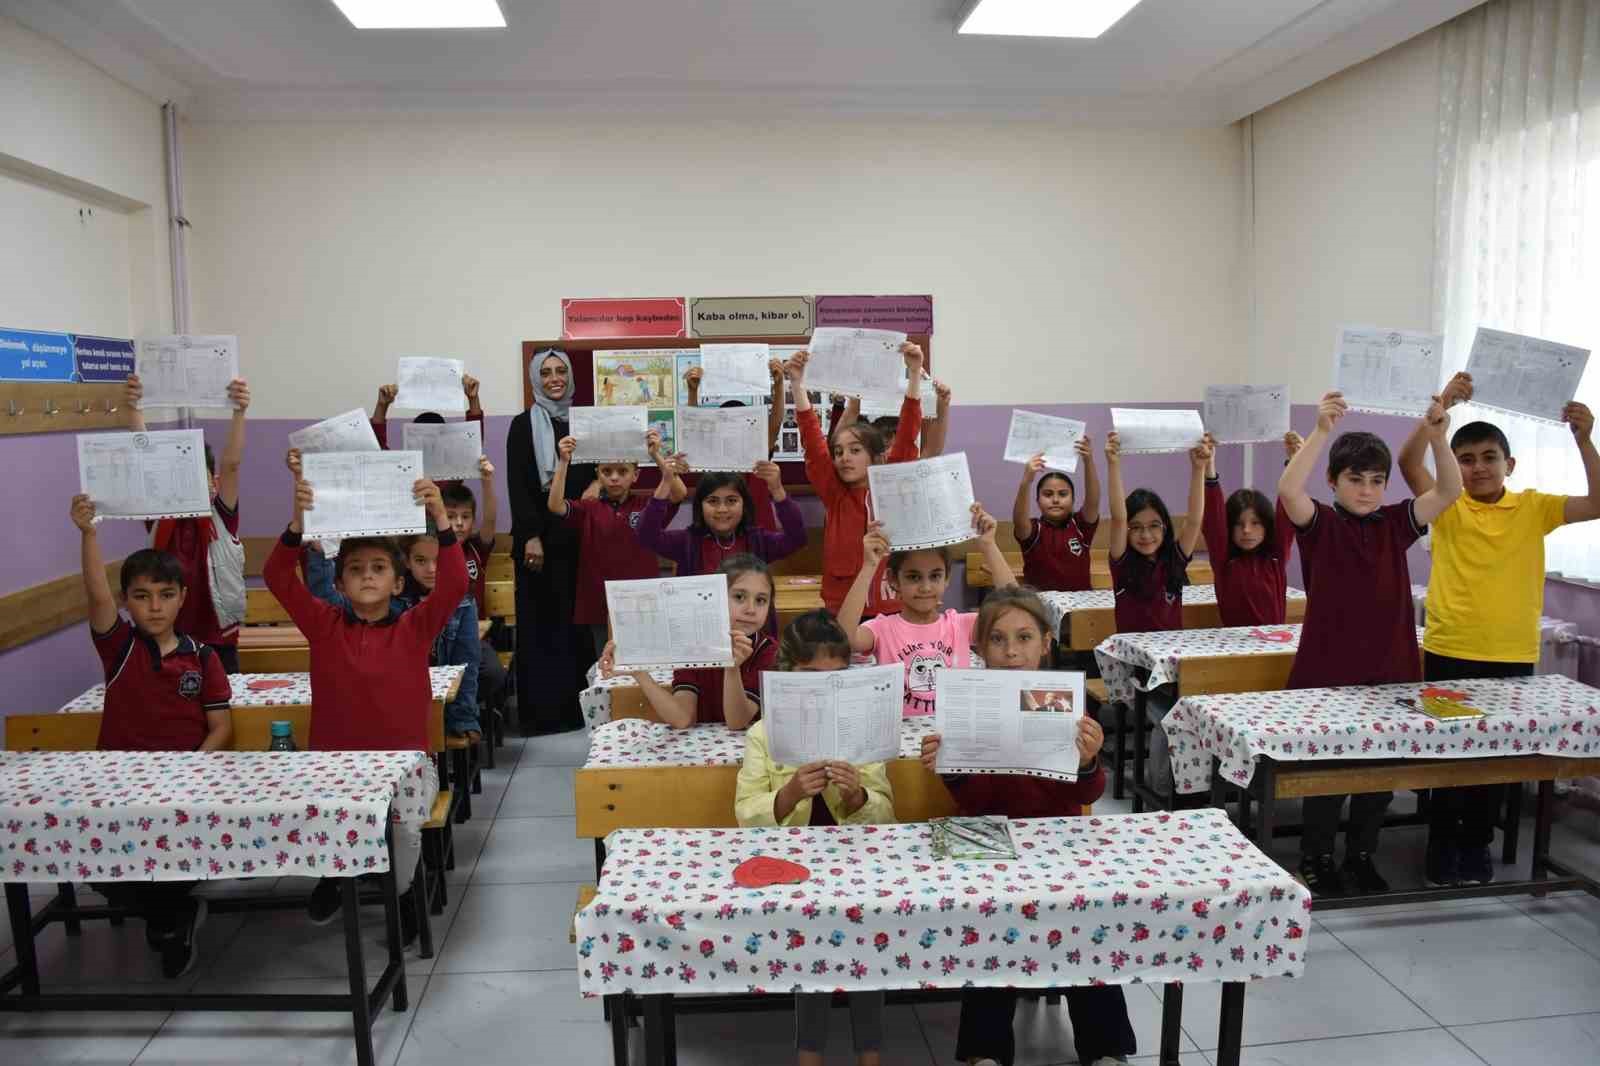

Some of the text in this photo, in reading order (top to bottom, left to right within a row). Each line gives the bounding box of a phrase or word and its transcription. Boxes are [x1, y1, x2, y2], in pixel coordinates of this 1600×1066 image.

[697, 310, 805, 321] Kaba olma, kibar ol.
[902, 642, 924, 656] LIKE
[930, 640, 953, 657] YOUR
